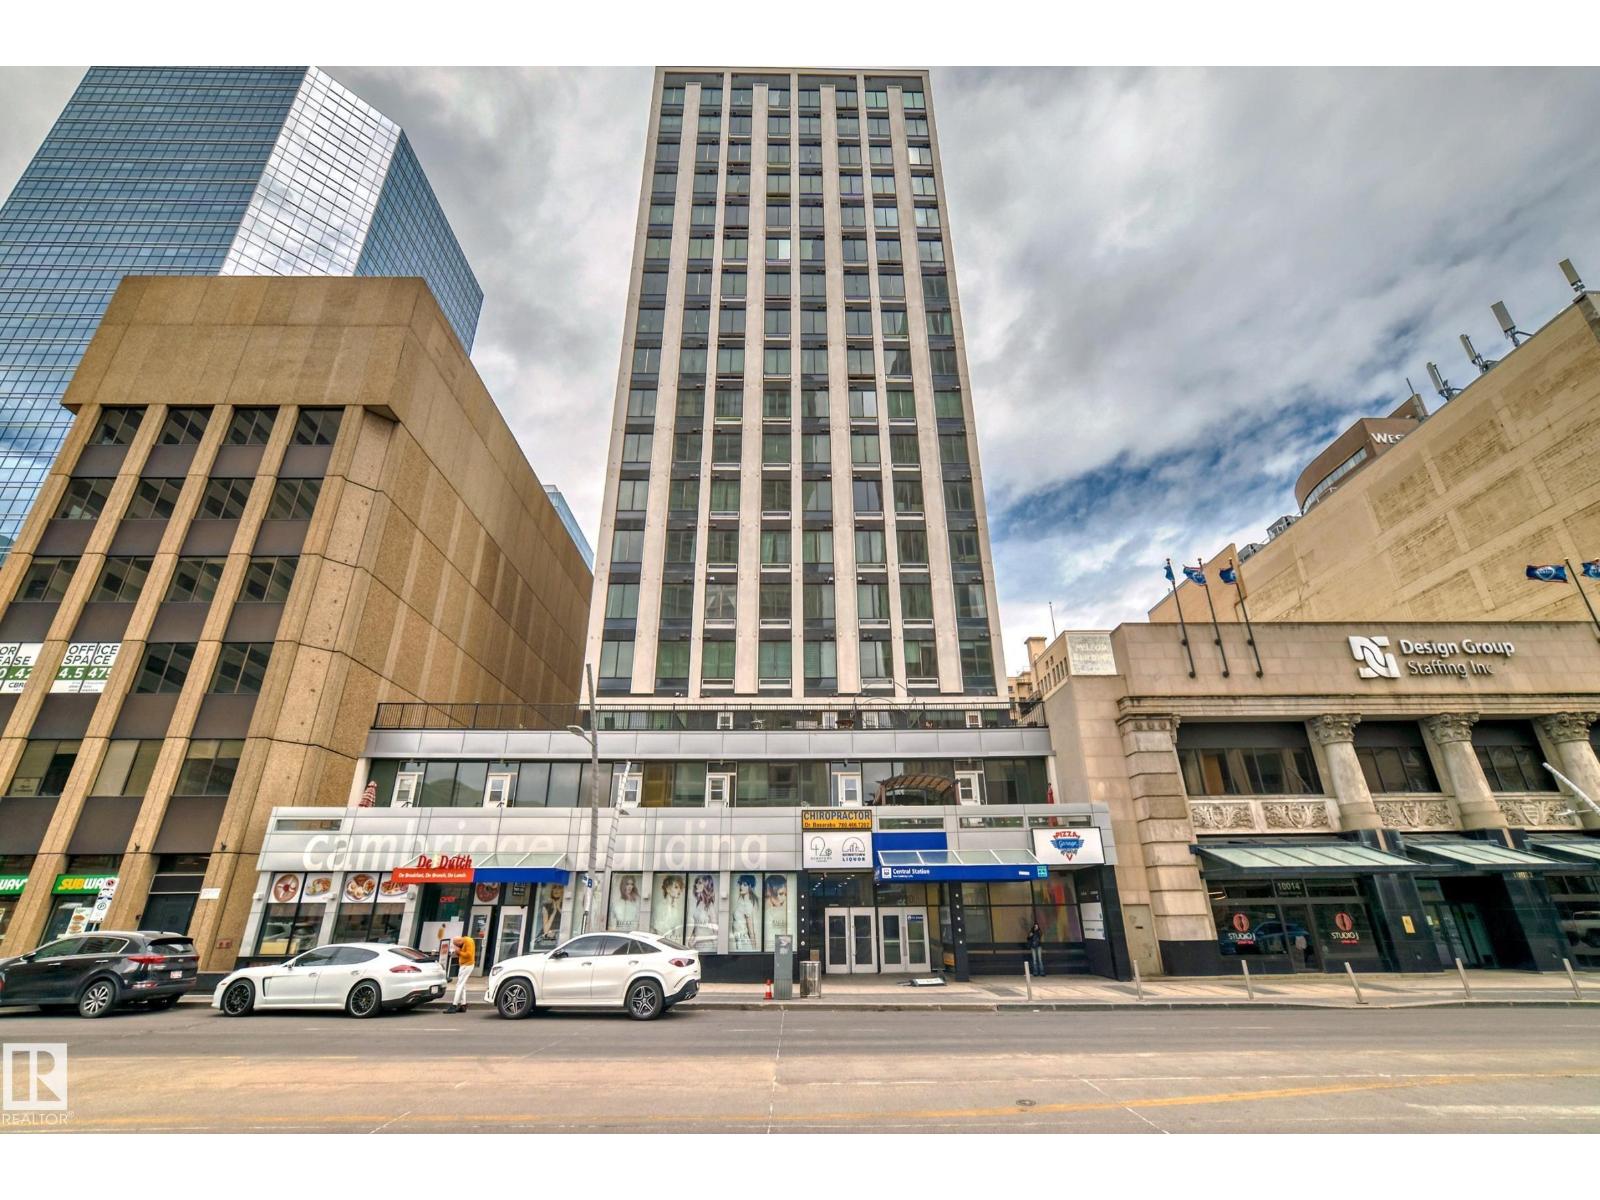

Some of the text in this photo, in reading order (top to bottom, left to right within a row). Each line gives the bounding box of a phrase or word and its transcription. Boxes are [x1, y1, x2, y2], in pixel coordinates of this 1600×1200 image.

[69, 645, 118, 655] OFFICE
[1400, 639, 1515, 658] Design Group
[64, 655, 111, 665] SPACE
[1408, 660, 1495, 678] Staffing Inc
[804, 811, 870, 820] CHIROPRACTOR
[303, 820, 555, 871] cambridge
[418, 854, 473, 869] De Dutch
[911, 868, 930, 876] Station
[1278, 882, 1301, 890] 10014
[1331, 932, 1355, 940] STUDIO
